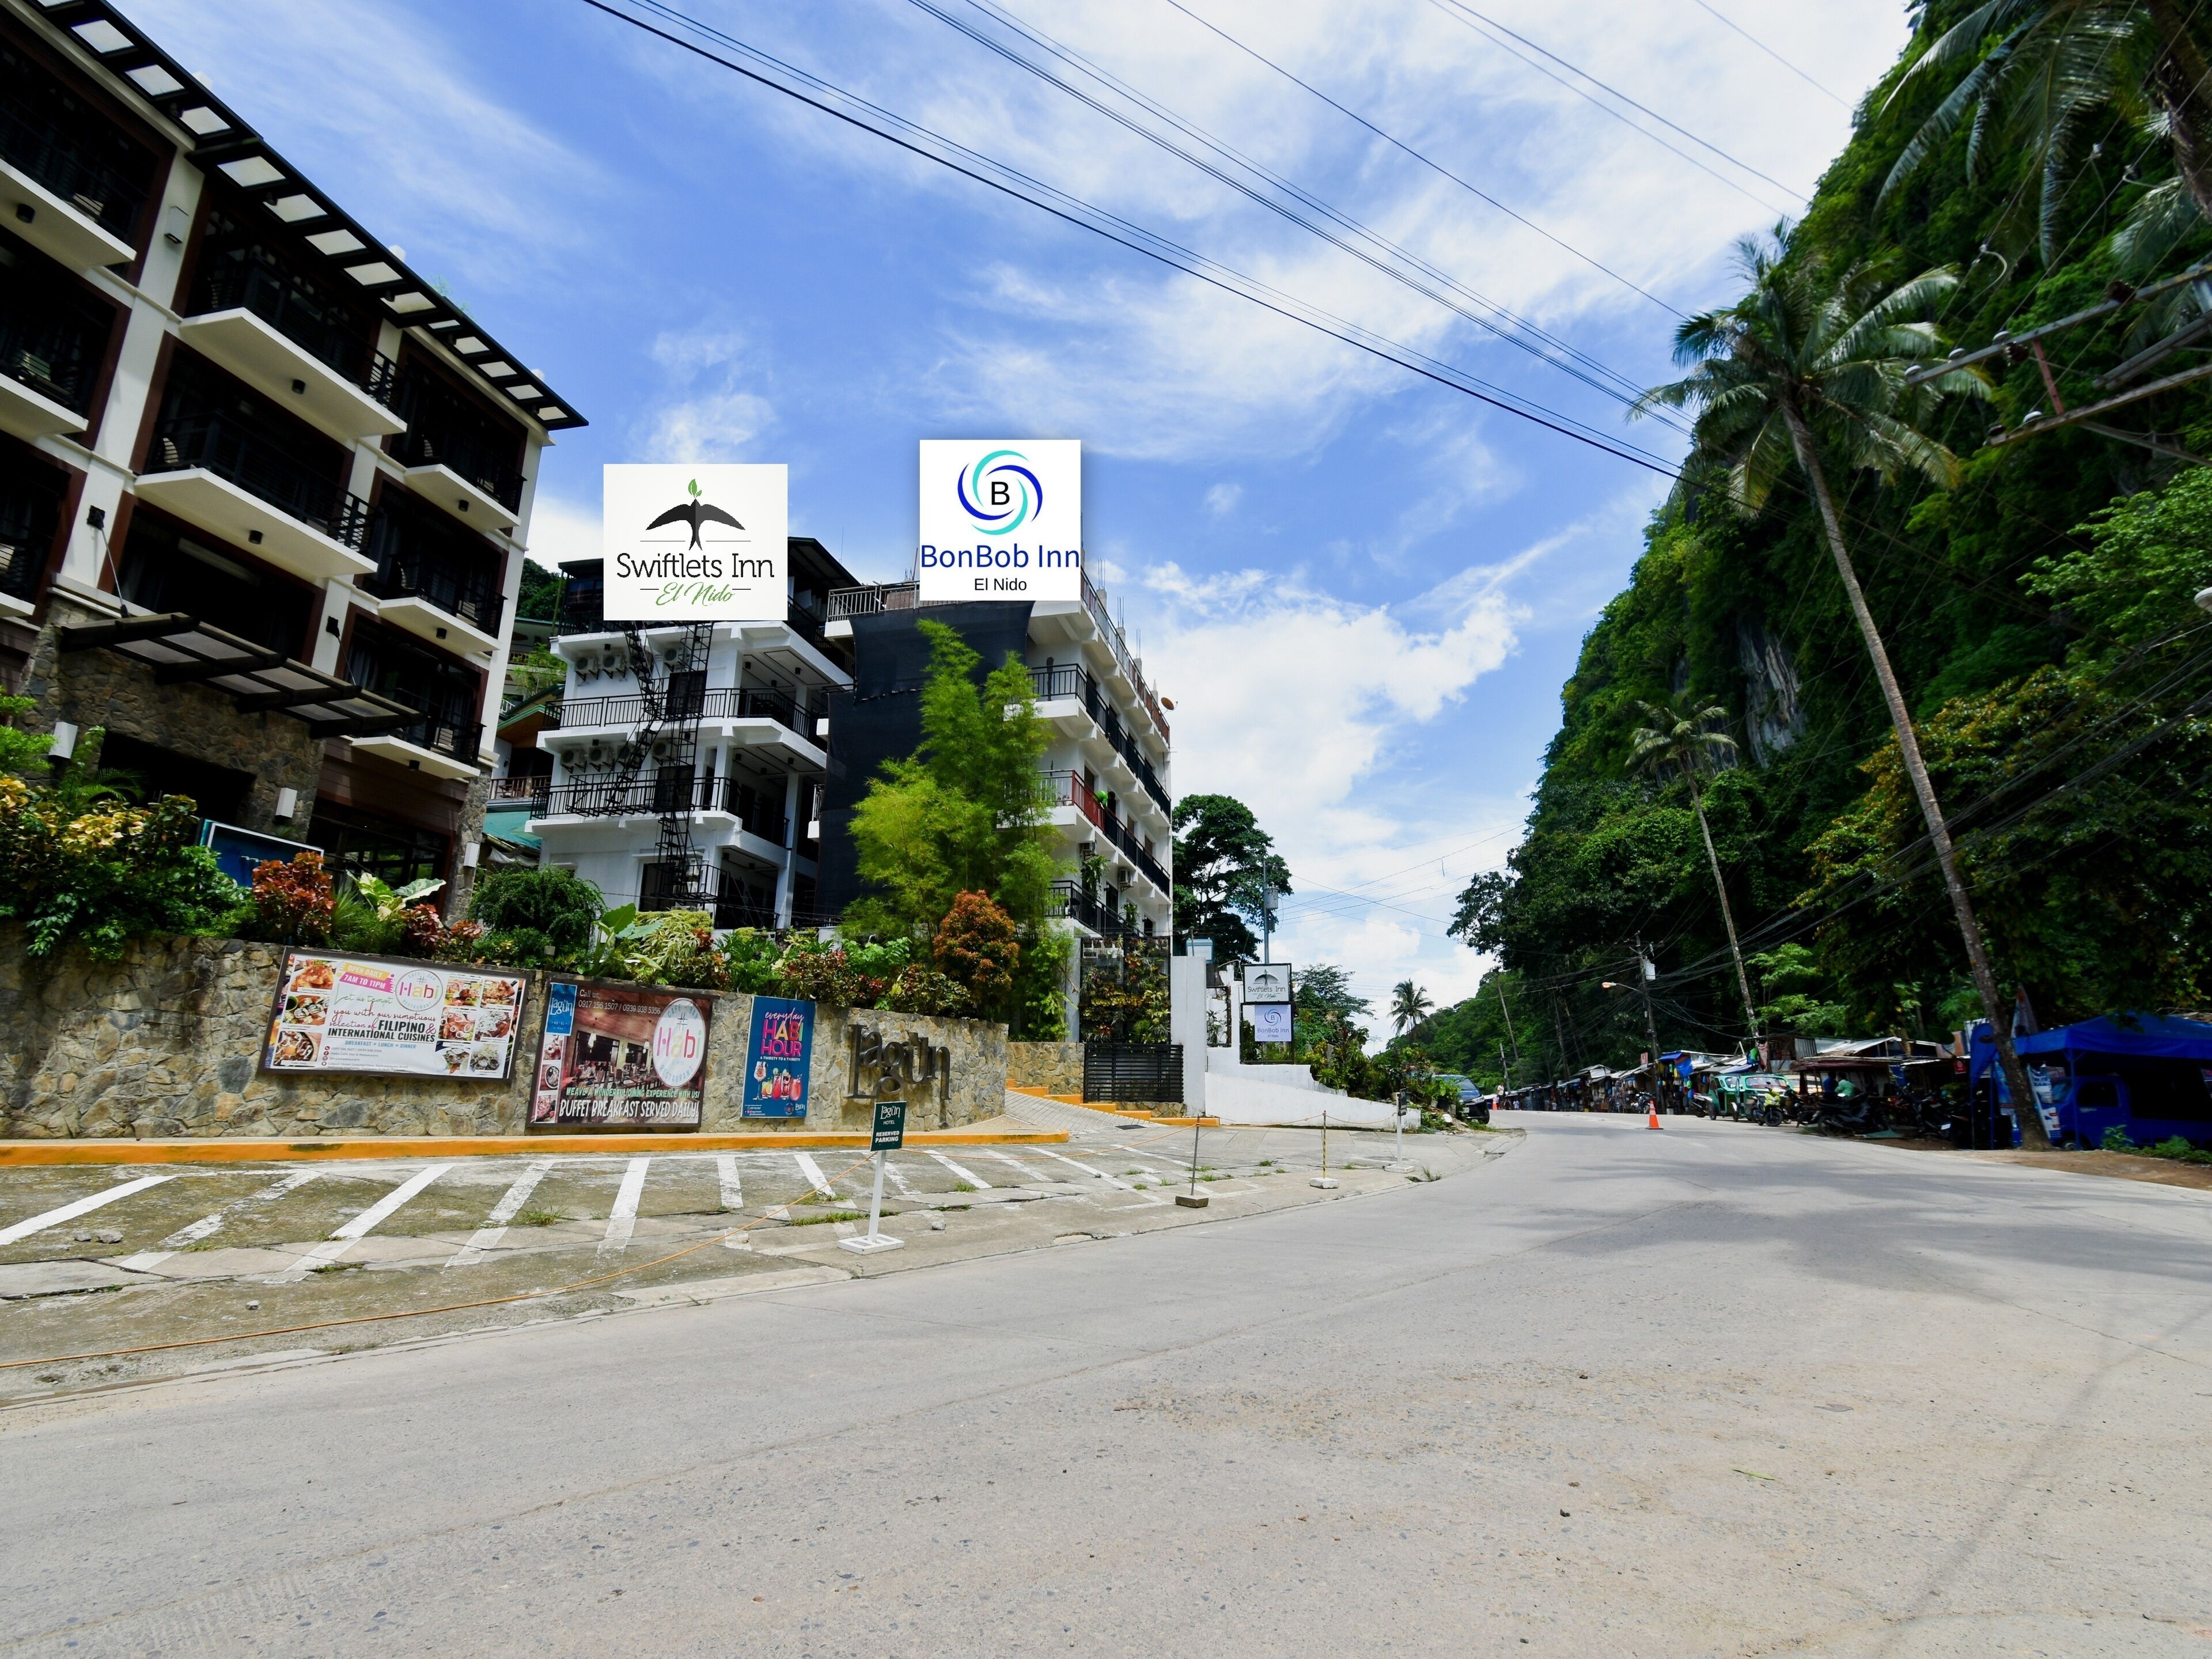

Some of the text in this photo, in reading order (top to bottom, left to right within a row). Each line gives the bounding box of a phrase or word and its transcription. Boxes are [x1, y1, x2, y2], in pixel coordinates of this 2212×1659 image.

[347, 965, 383, 979] OPEN DAILY
[344, 975, 358, 983] 7AM
[370, 980, 386, 989] 11PM
[399, 982, 440, 999] Habi
[334, 983, 354, 1005] Let
[368, 994, 394, 1005] tempt
[579, 989, 591, 997] Call
[332, 1009, 351, 1022] you
[354, 1001, 374, 1017] with
[393, 1012, 436, 1022] sumptuous
[623, 1004, 636, 1012] 0939
[649, 1006, 661, 1014] 5356
[668, 1004, 681, 1018] CAFE
[765, 1007, 804, 1027] everyday
[329, 1015, 437, 1035] selection of FILIPINO &
[762, 1019, 804, 1041] HABI
[328, 1028, 435, 1042] INTERNATIONAL CUISINES
[657, 1027, 702, 1059] Habi
[761, 1039, 802, 1056] HOUR
[659, 1065, 694, 1083] RESTAURANT
[566, 1087, 586, 1096] WEAVE
[594, 1088, 626, 1097] WONDERFUL
[646, 1089, 677, 1098] EXPERIENCE
[691, 1090, 700, 1099] US!
[559, 1100, 699, 1118] BUFFET BREAKFAST SERVED DAILY!
